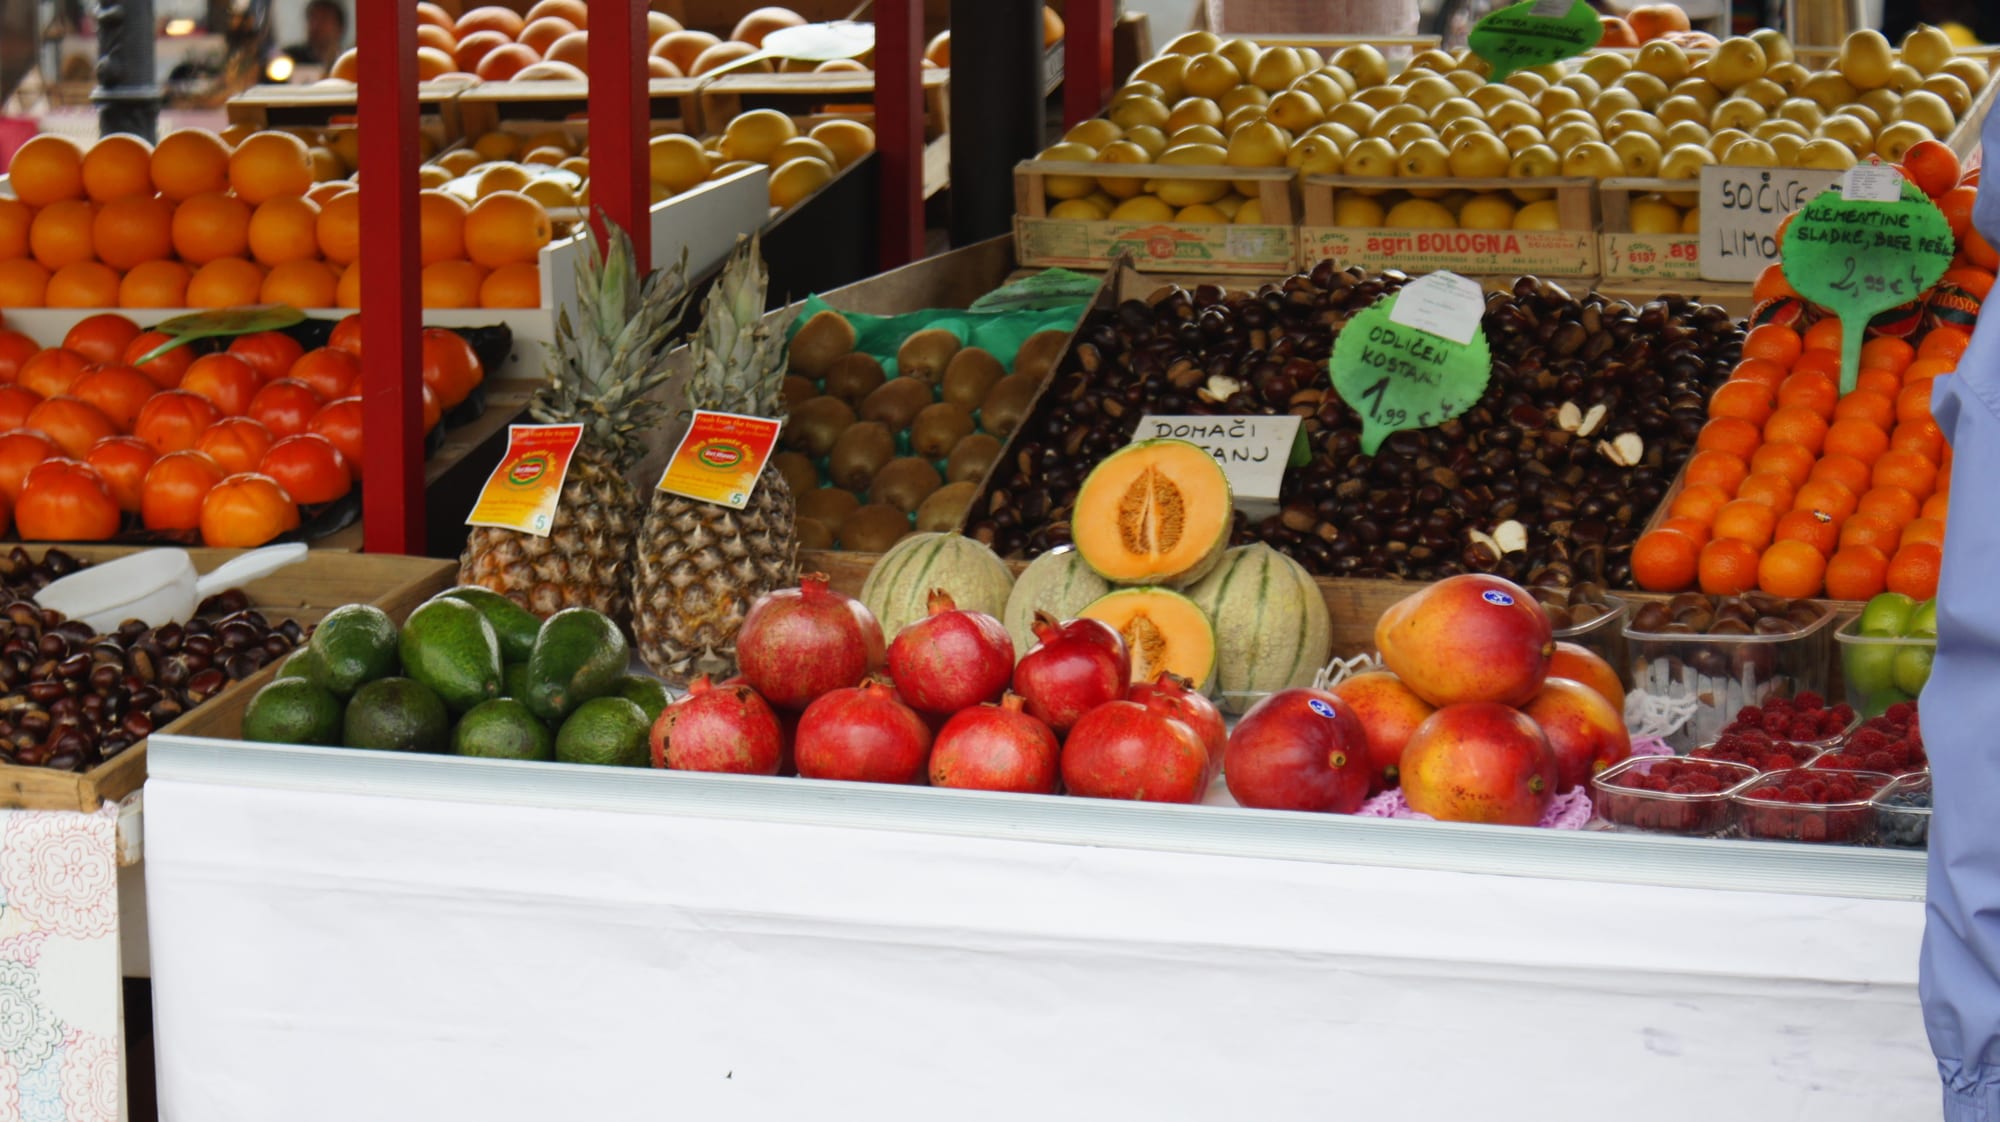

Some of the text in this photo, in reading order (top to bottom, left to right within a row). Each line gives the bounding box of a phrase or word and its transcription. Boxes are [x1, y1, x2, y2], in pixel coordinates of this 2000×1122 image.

[1803, 206, 1911, 229] KLEMENTINE
[1367, 236, 1413, 257] agri
[1417, 232, 1521, 255] BOLOGNA
[1629, 252, 1657, 263] 6137
[1368, 325, 1449, 367] ODLIČEN
[1155, 418, 1256, 439] DOMAČI
[731, 493, 743, 504] 5
[535, 514, 546, 530] 5
